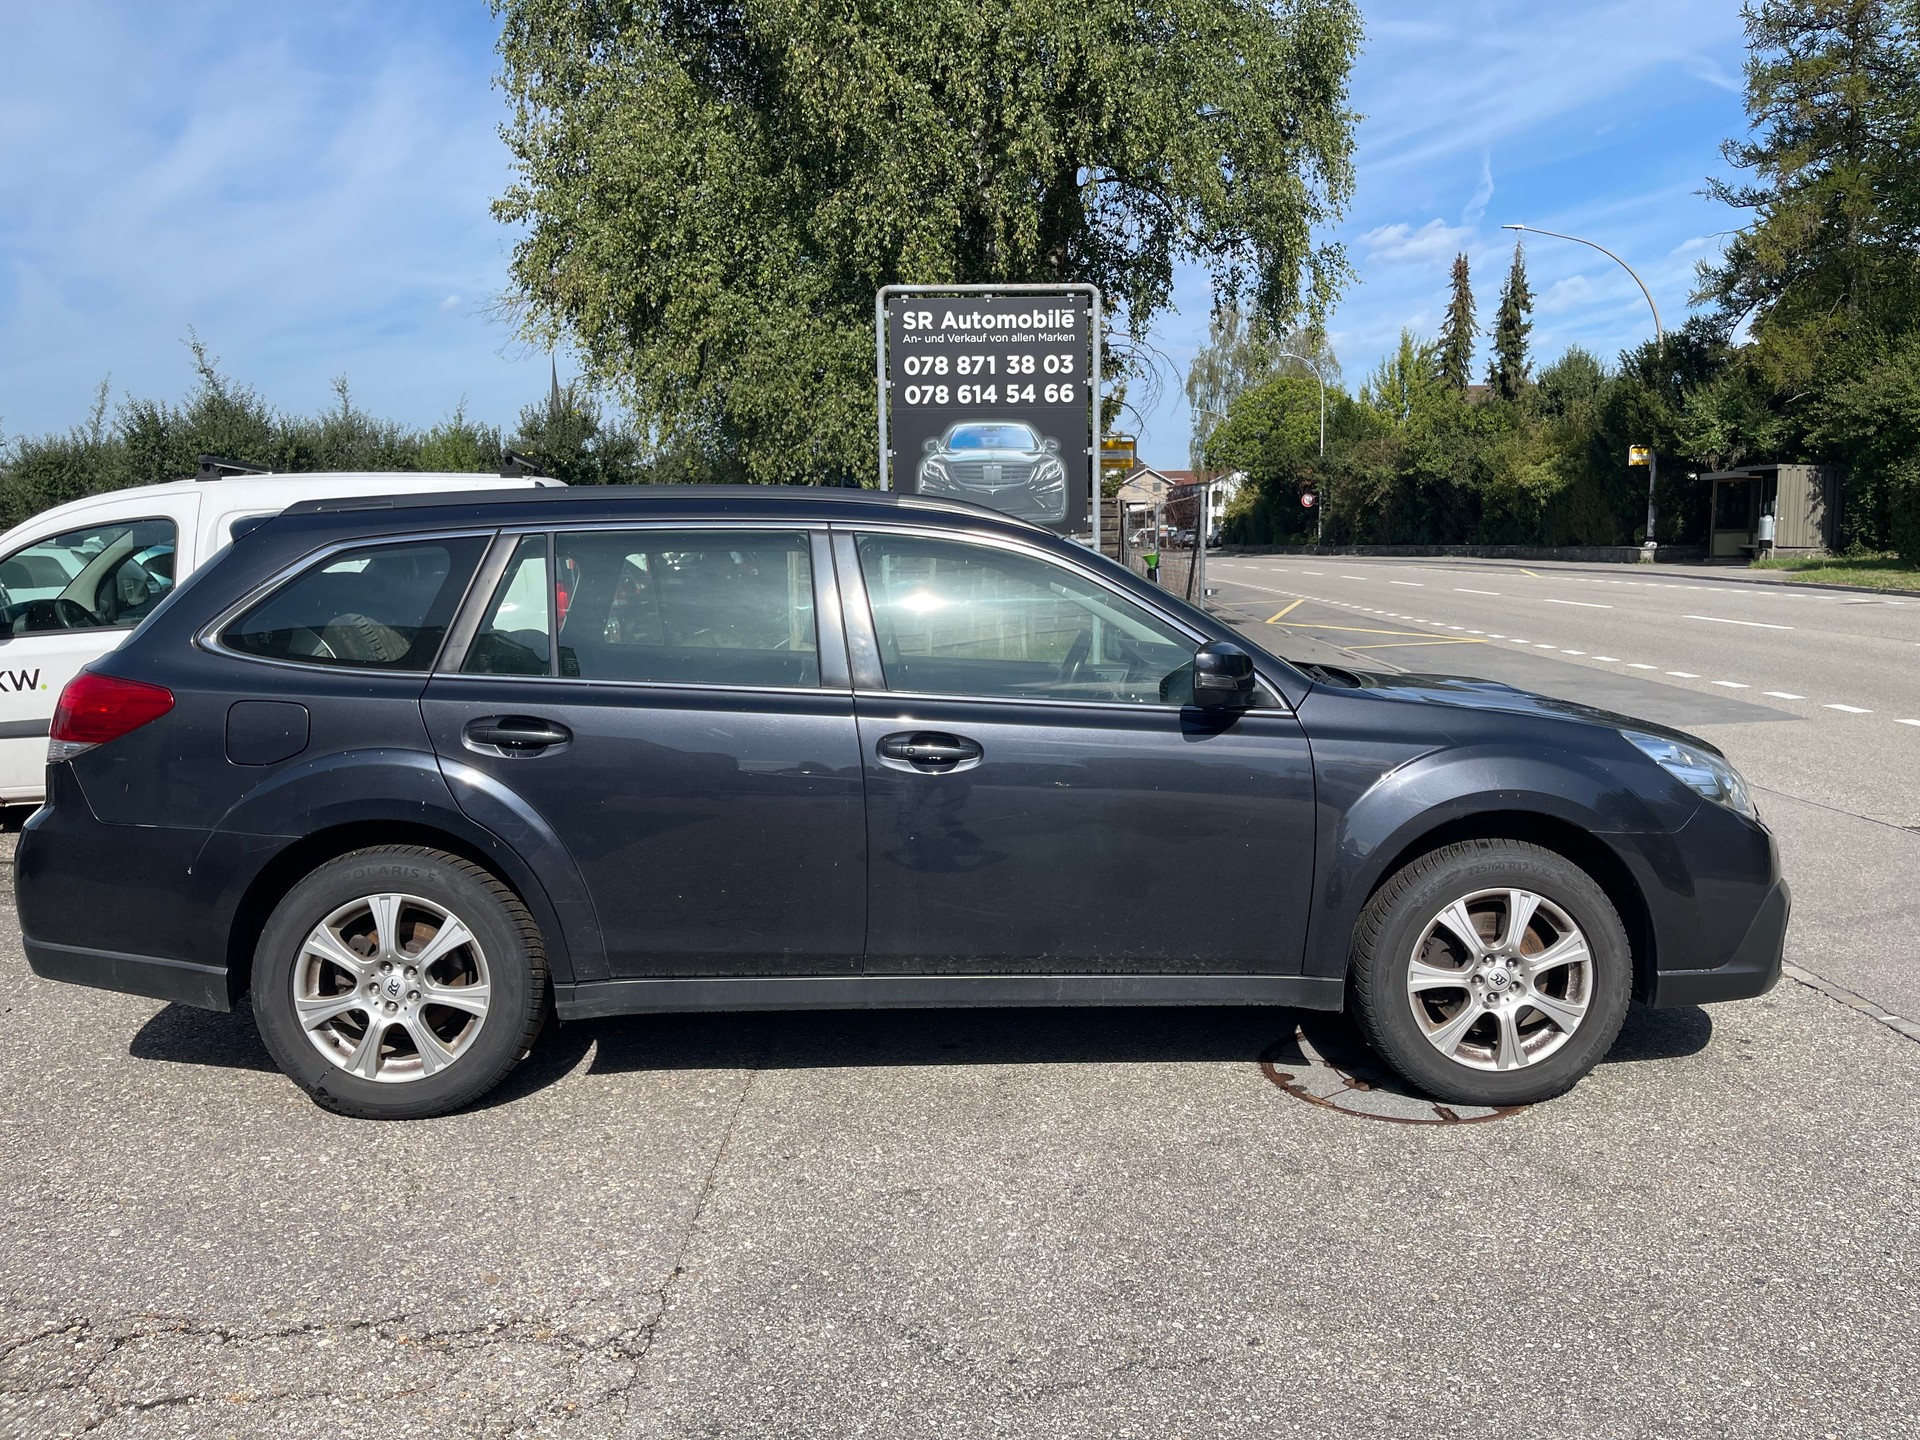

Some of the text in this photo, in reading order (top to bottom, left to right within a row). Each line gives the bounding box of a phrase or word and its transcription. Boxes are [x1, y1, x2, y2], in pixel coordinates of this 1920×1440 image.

[902, 309, 1075, 330] SR Automobile
[902, 331, 1076, 344] An- und Verkauf von allen Marken
[903, 354, 1074, 376] 078 871 38 03
[904, 383, 1075, 405] 078 614 54 66
